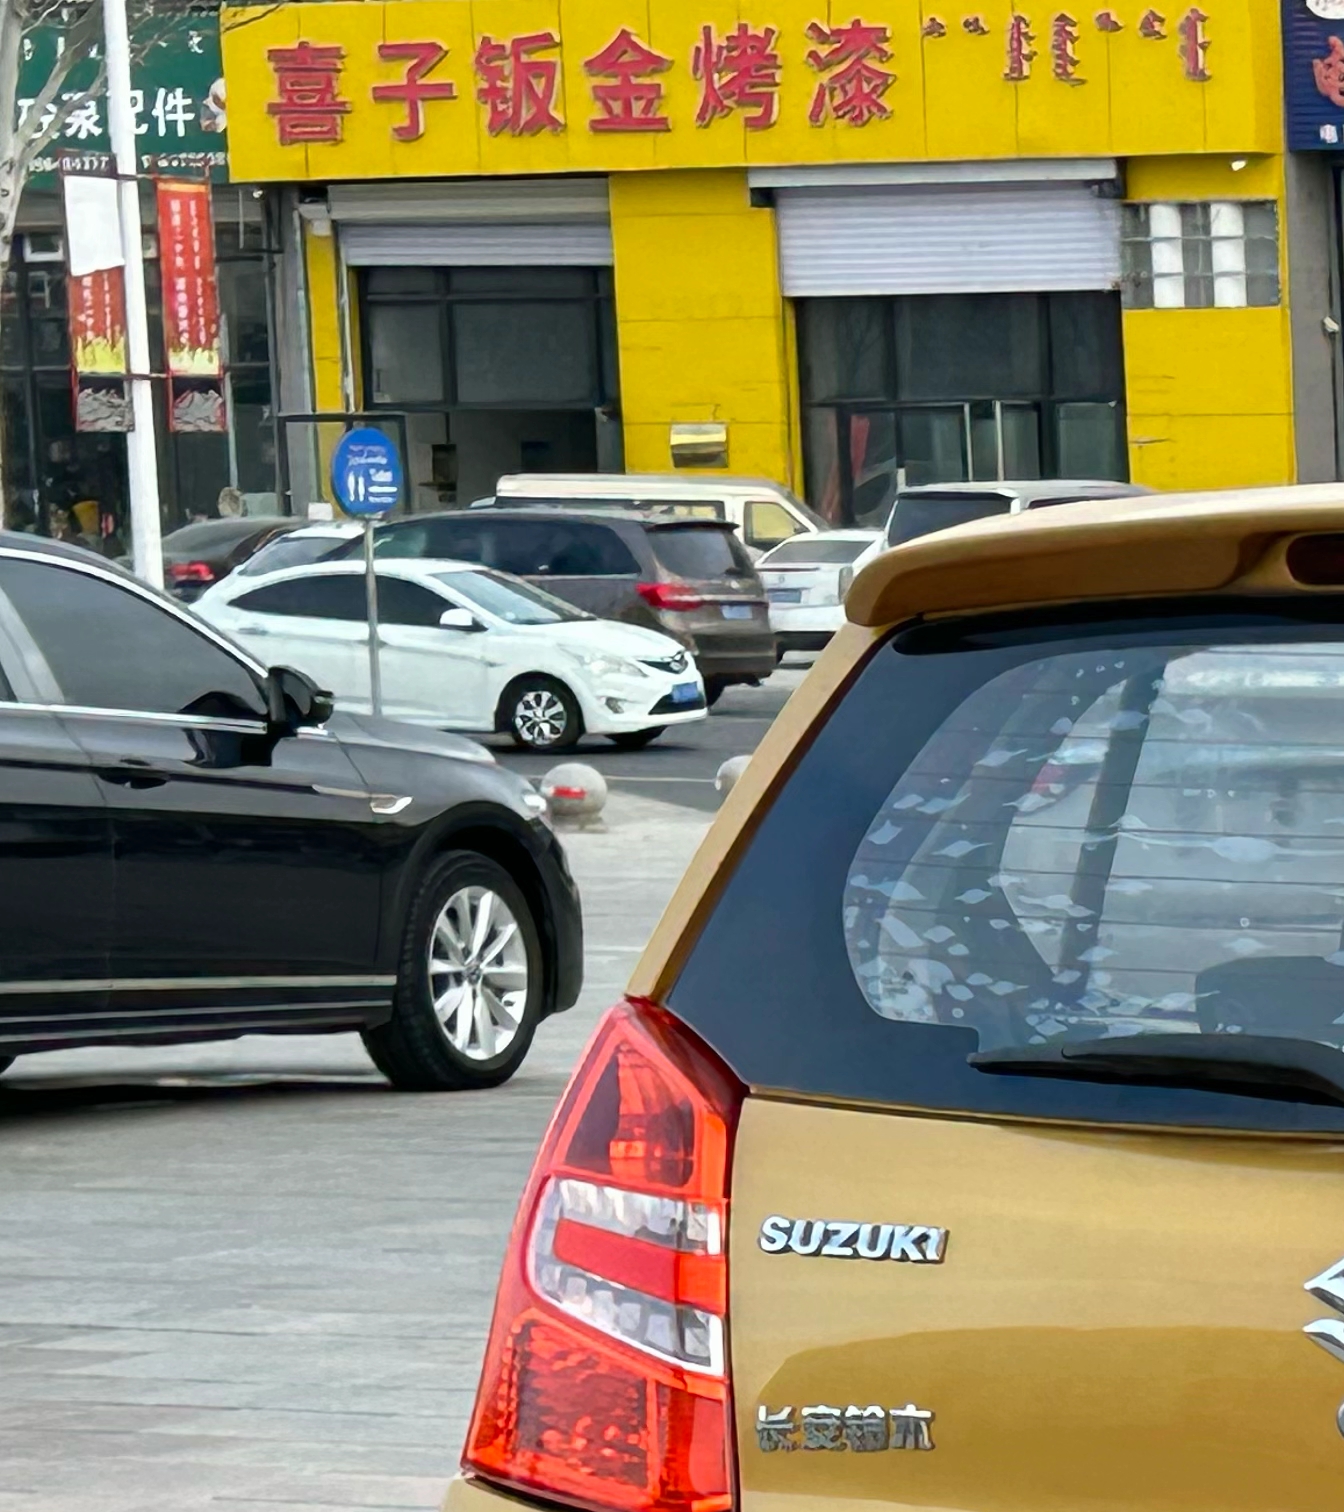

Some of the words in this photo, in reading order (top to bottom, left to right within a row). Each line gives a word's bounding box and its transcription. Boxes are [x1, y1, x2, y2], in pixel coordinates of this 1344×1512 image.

[265, 18, 897, 145] 喜子钣金烤漆
[757, 1214, 949, 1264] SUZUKI
